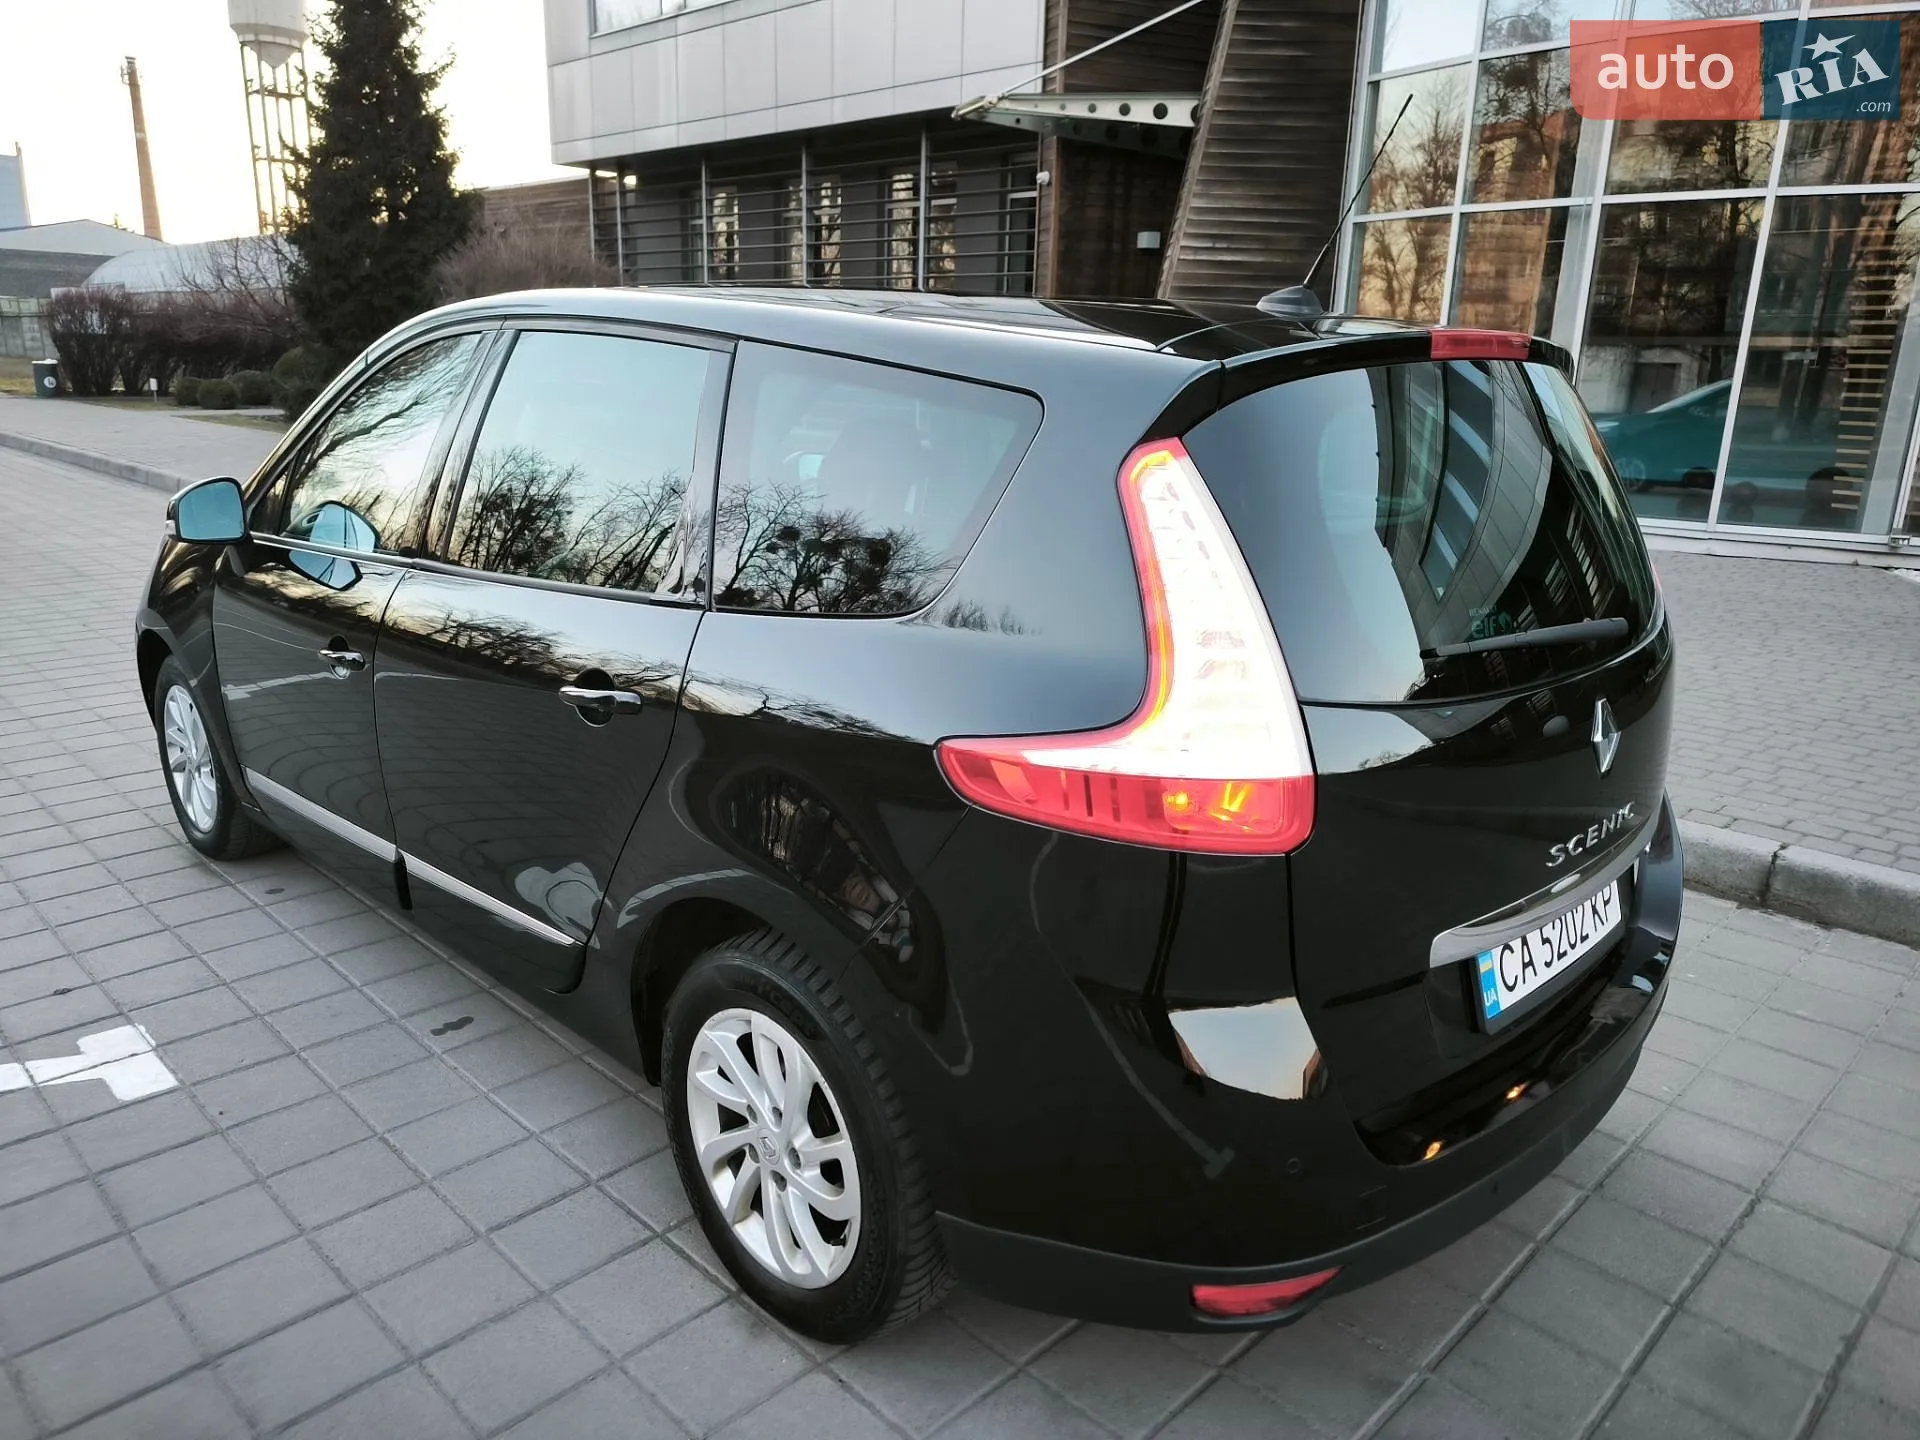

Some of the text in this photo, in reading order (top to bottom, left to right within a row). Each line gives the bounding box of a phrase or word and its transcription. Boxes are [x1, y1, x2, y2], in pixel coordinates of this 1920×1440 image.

[1545, 800, 1636, 867] SCENIC
[1499, 883, 1613, 993] CA 5202 KP
[1484, 990, 1498, 1007] UA
